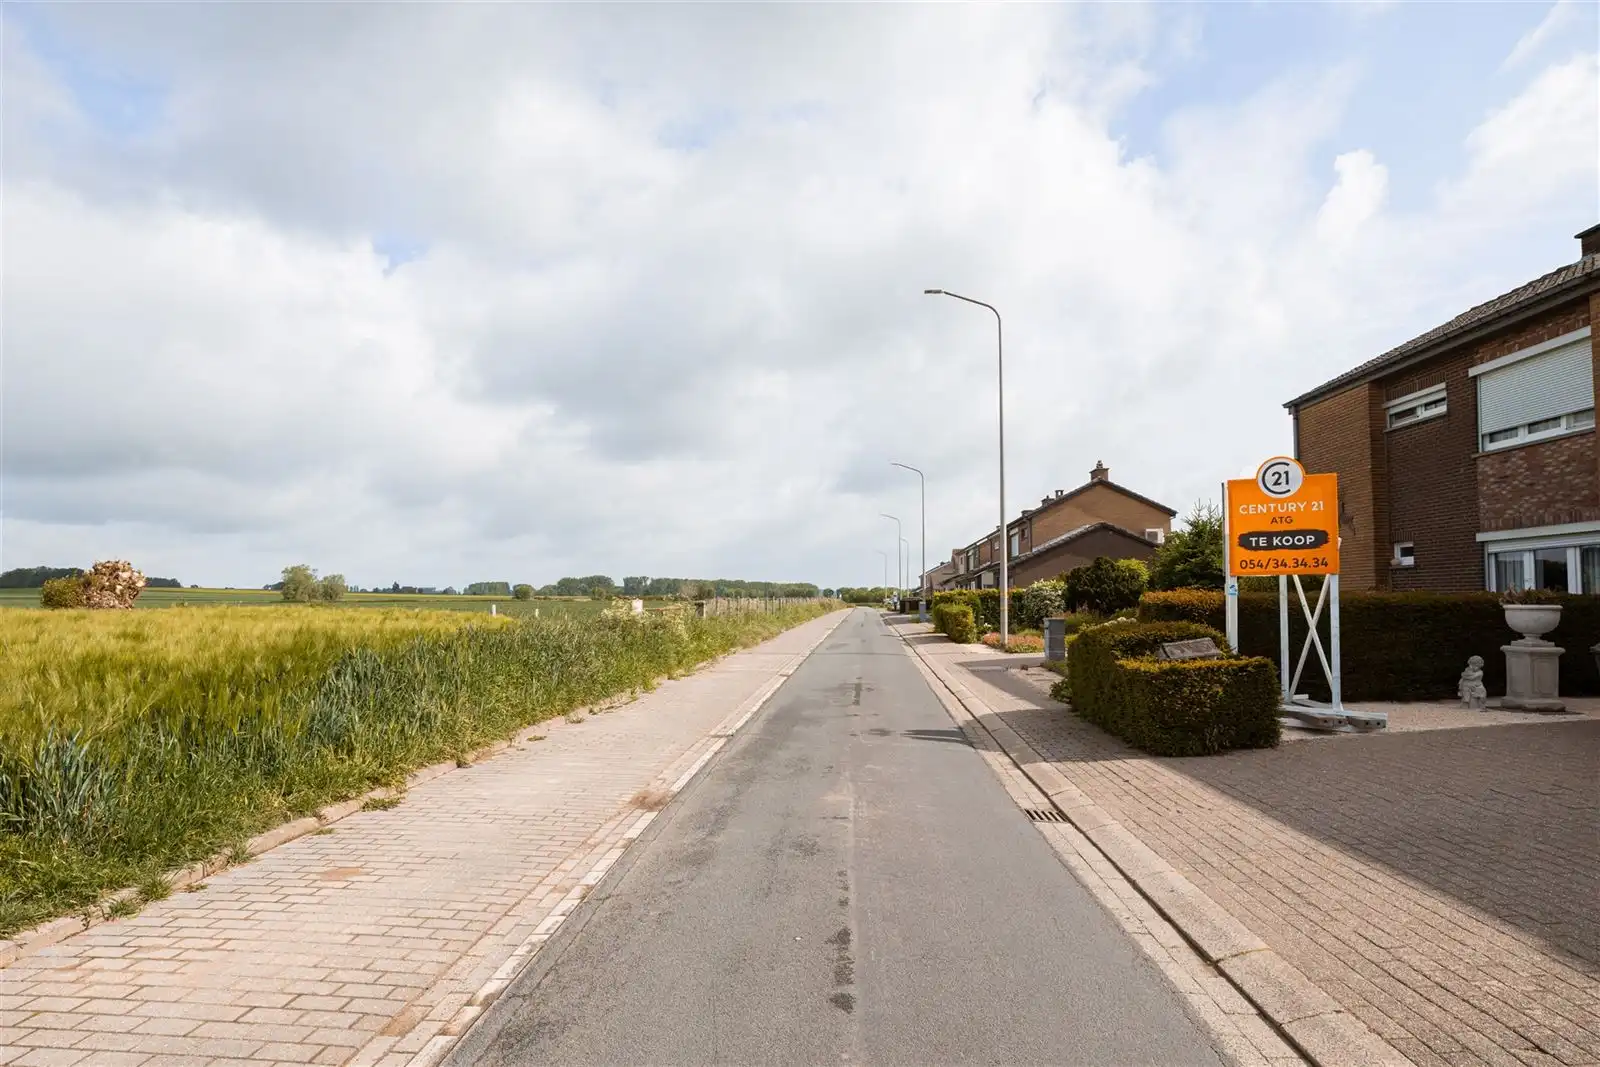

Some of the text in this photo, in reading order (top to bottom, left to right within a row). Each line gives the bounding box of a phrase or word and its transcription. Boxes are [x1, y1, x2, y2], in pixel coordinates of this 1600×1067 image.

[1239, 501, 1324, 515] CENTURY 21
[1270, 515, 1293, 524] ATG
[1249, 535, 1315, 547] TE KOOP
[1239, 557, 1328, 570] 054/34.34.34
